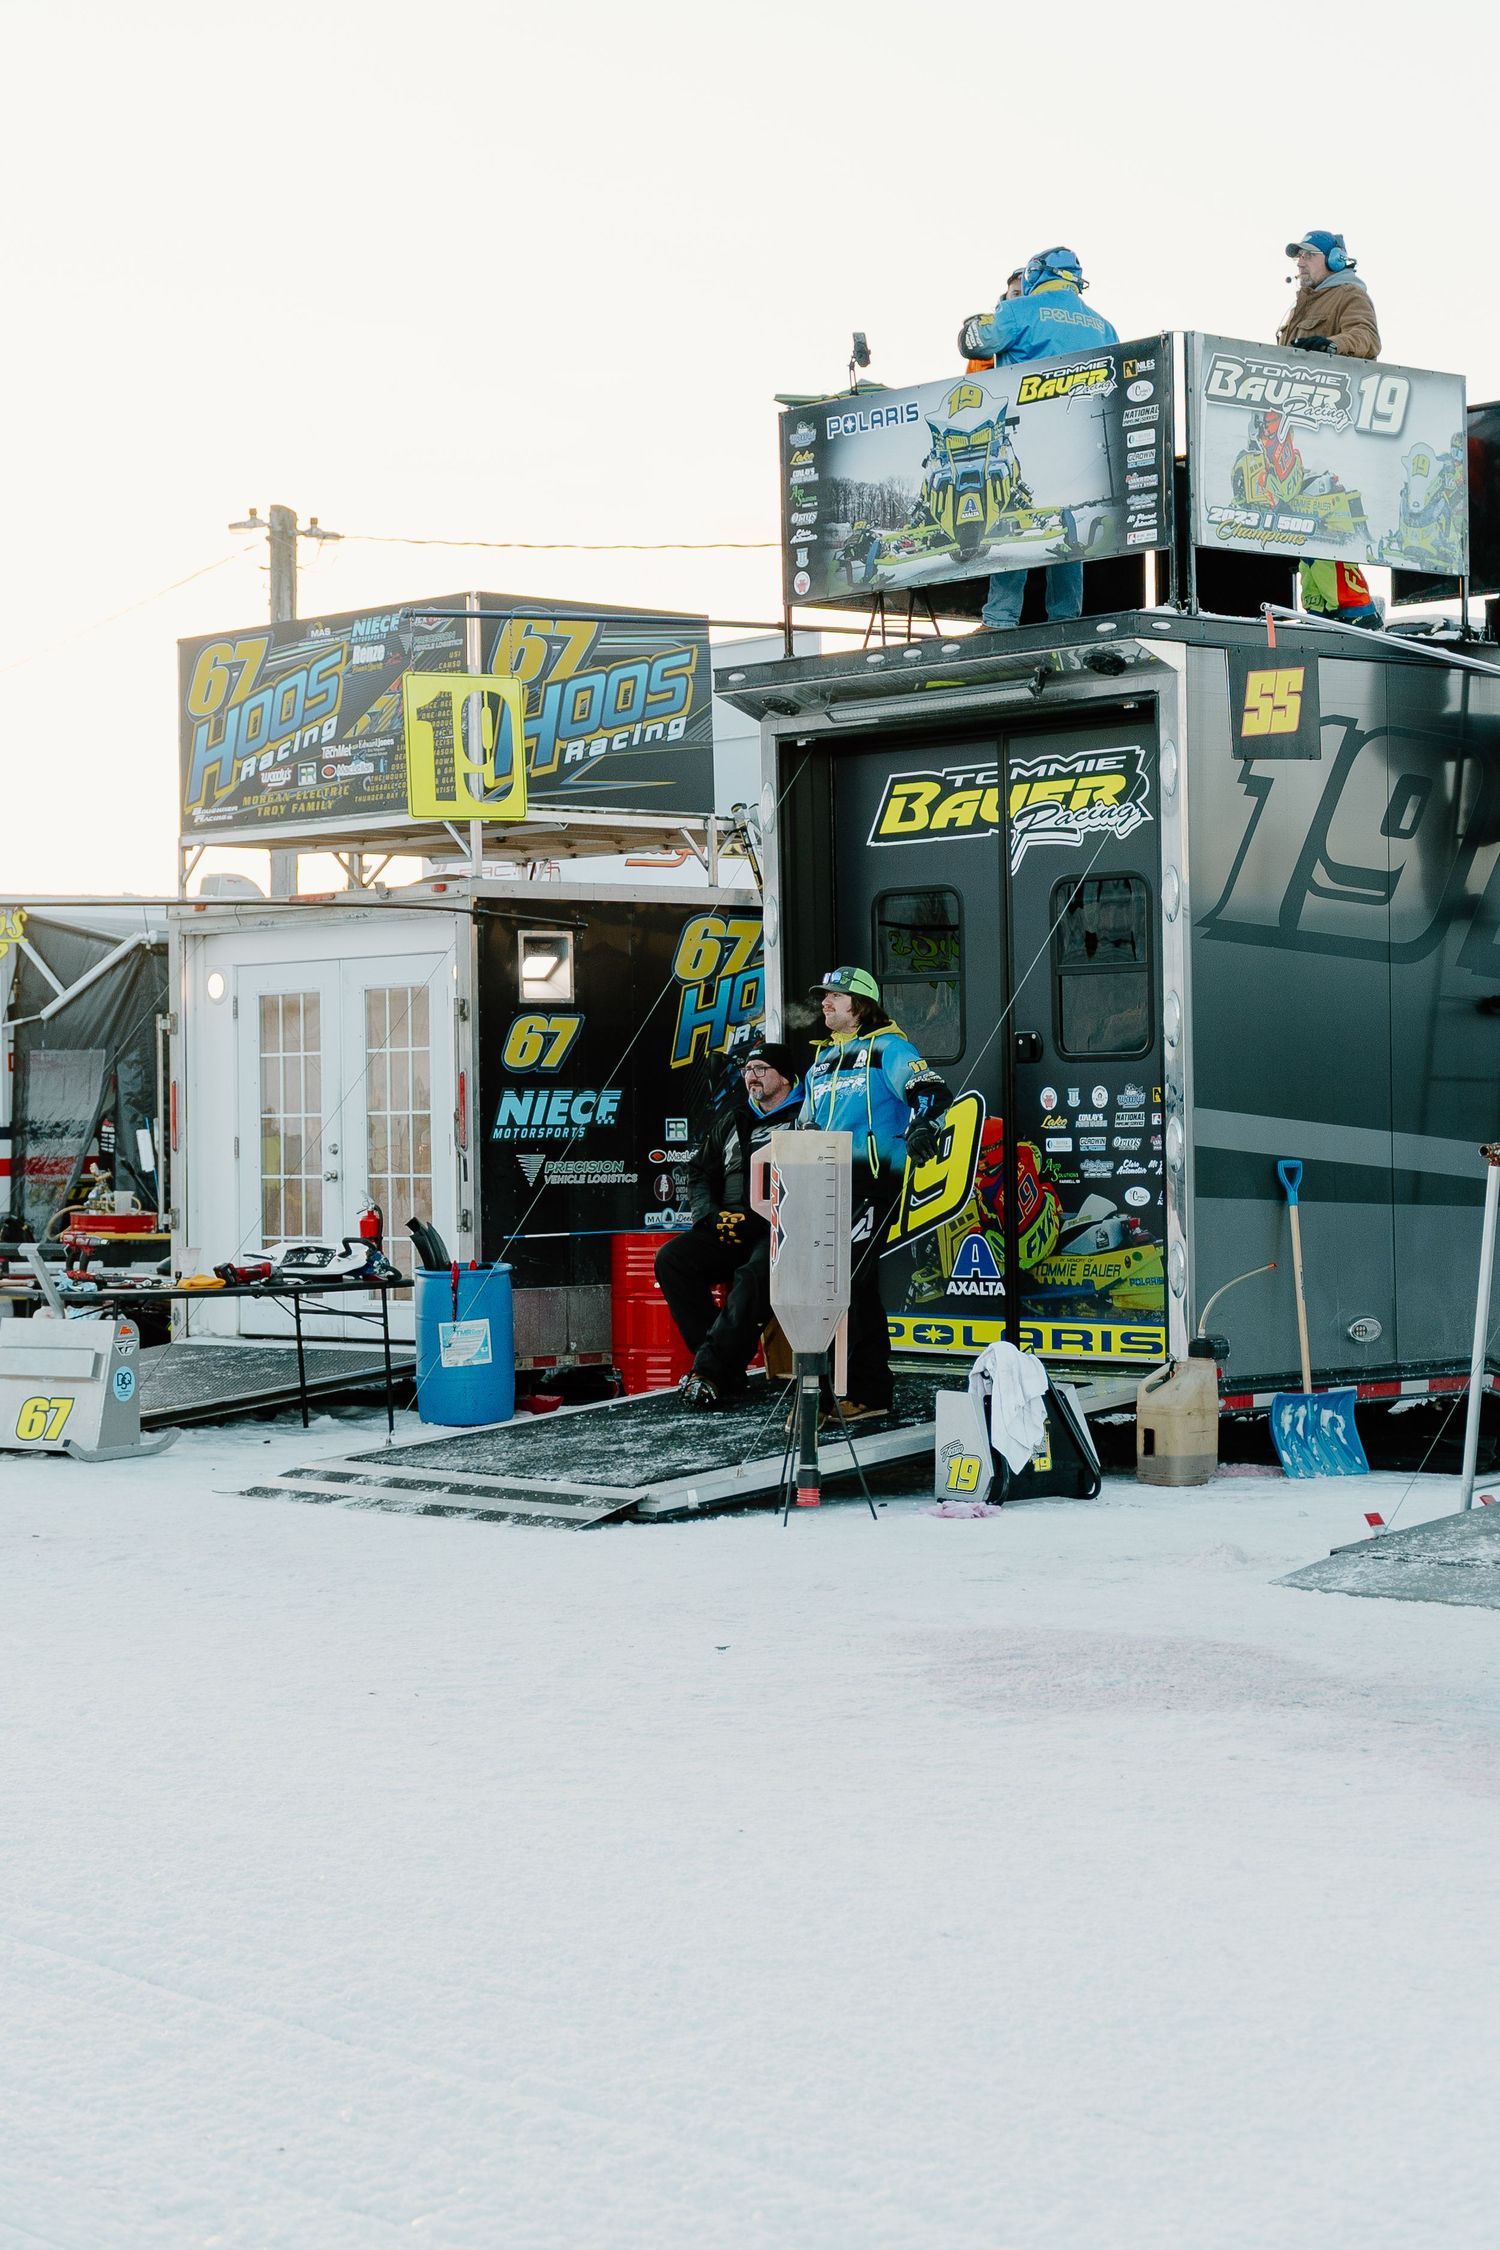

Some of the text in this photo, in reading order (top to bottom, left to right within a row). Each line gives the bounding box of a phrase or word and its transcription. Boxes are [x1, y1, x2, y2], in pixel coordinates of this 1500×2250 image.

[1040, 308, 1105, 333] POLARIS
[1043, 360, 1108, 379] TOMMIE
[1137, 359, 1156, 369] NILES
[1246, 363, 1342, 386] TOMMIE
[948, 384, 983, 419] 19
[1019, 368, 1108, 403] BAUER
[1066, 380, 1114, 414] Racing
[1207, 361, 1411, 434] BAUER 19
[827, 401, 919, 439] POLARIS
[1124, 406, 1159, 420] NATIONAL
[1278, 397, 1349, 443] Racing
[1208, 506, 1260, 529] 2023
[1277, 514, 1316, 535] 500
[1216, 519, 1307, 549] Champions
[352, 614, 400, 638] NIECE
[491, 615, 599, 685] 67
[187, 637, 269, 716] 67
[186, 643, 346, 810] HOOS
[493, 648, 697, 778] HOOS
[239, 715, 338, 782] Racing
[416, 691, 514, 803] 19
[564, 716, 688, 764] Racing
[946, 755, 1126, 787] TOMMIE
[242, 785, 350, 806] MORGAN ELECTRIC
[257, 800, 334, 817] TROY FAMILY
[879, 774, 1127, 835] BAUER
[1010, 800, 1145, 877] Racing
[1194, 714, 1484, 963] 19
[674, 917, 765, 980] 67
[503, 1015, 582, 1068] 67
[496, 1090, 623, 1125] NIECE
[1116, 1112, 1145, 1121] NATIONAL
[493, 1127, 586, 1139] MOTORSPORTS
[543, 1173, 638, 1184] VEHICLE LOGISTICS
[544, 1160, 624, 1173] PRECISION
[1035, 1263, 1121, 1277] TOMMIE BAUER
[946, 1281, 1005, 1296] AXALTA
[15, 1396, 76, 1441] 67
[940, 1439, 964, 1463] Team
[1032, 1456, 1051, 1472] 19
[946, 1455, 982, 1493] 19
